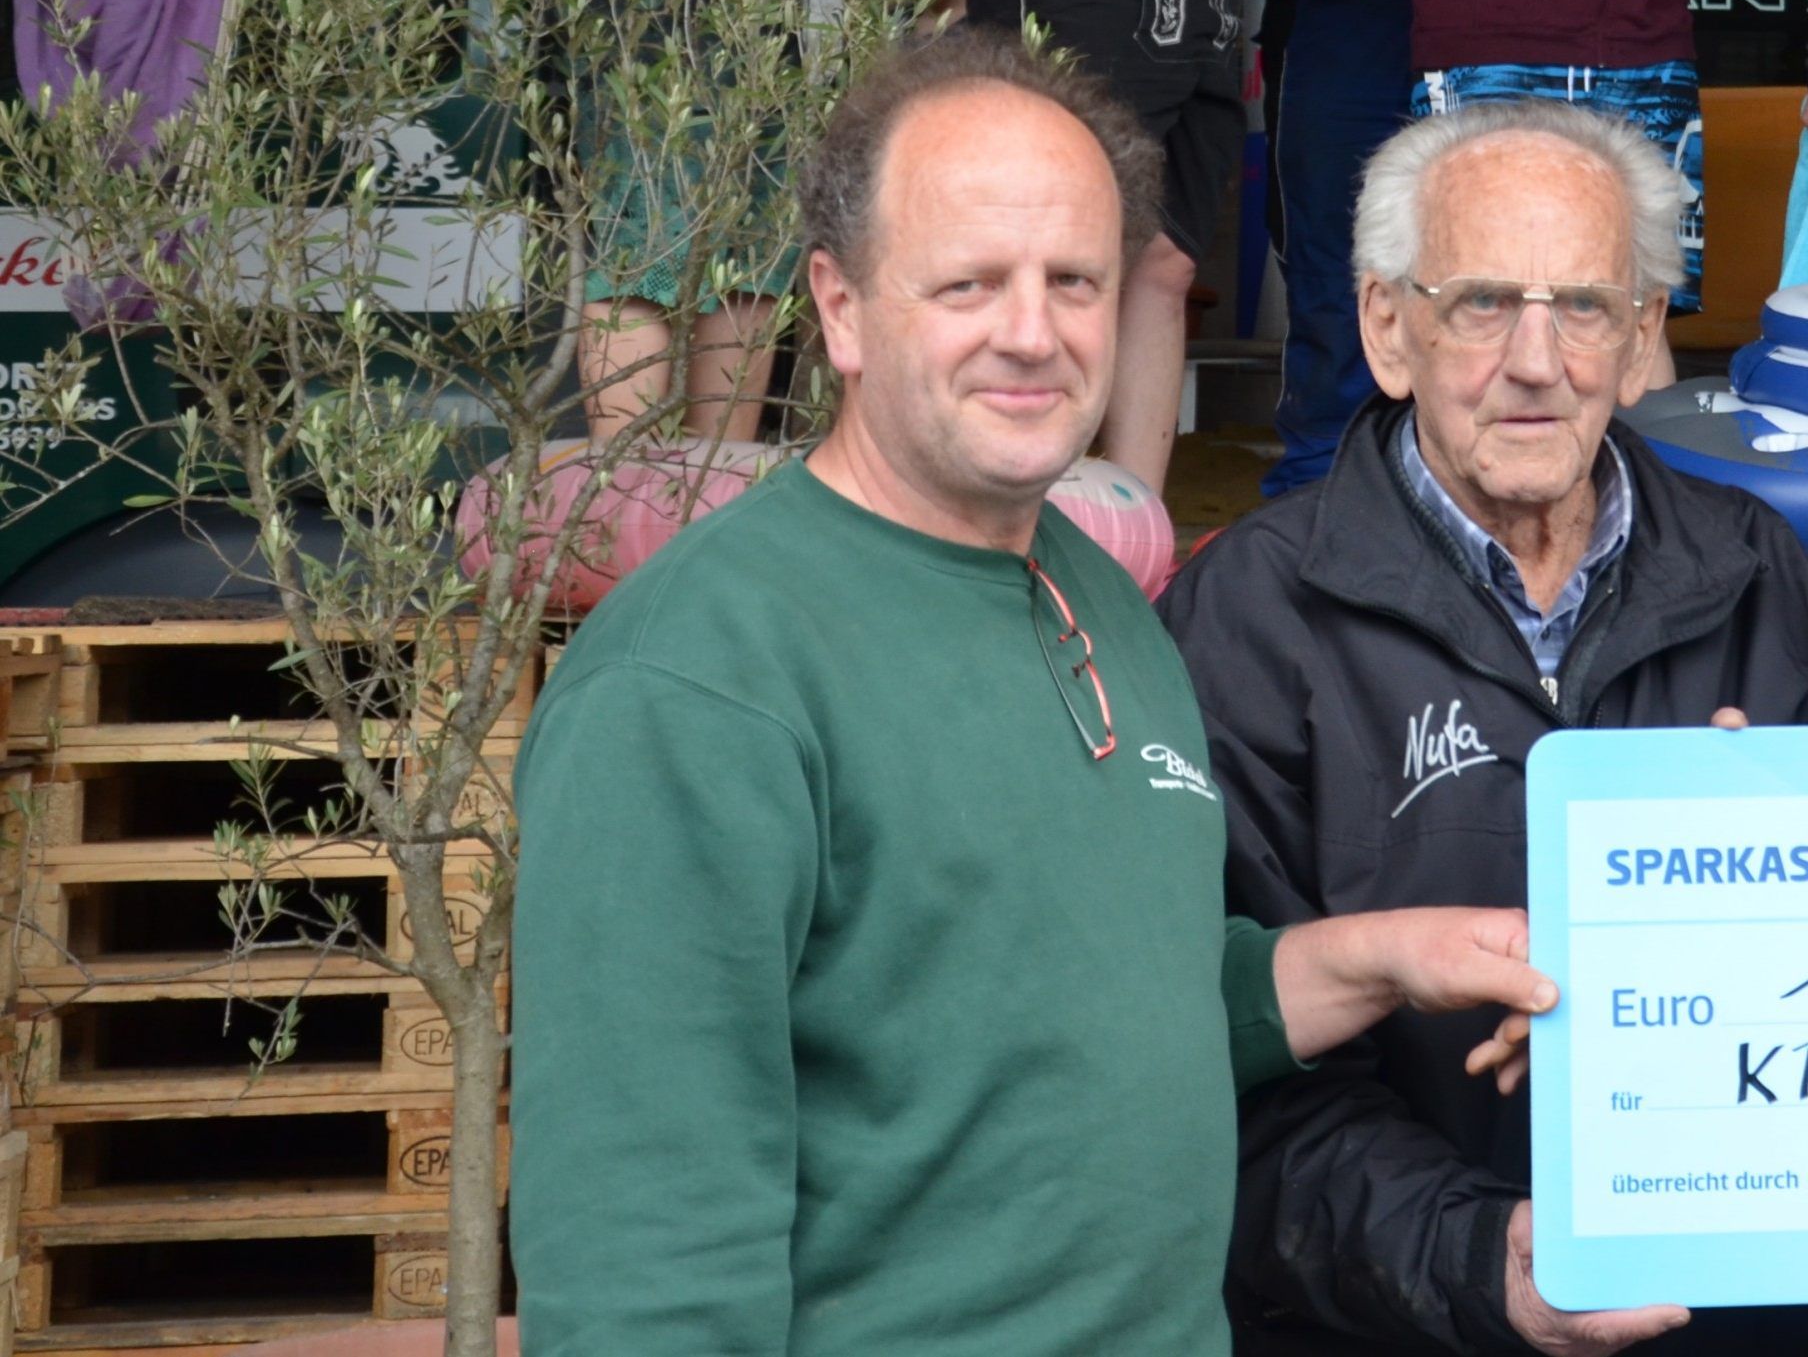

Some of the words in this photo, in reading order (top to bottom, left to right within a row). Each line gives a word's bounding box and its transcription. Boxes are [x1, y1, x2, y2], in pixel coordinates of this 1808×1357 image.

[1612, 989, 1714, 1027] Euro
[1611, 1091, 1643, 1111] für
[1612, 1173, 1729, 1194] überreicht
[1736, 1170, 1799, 1190] durch
